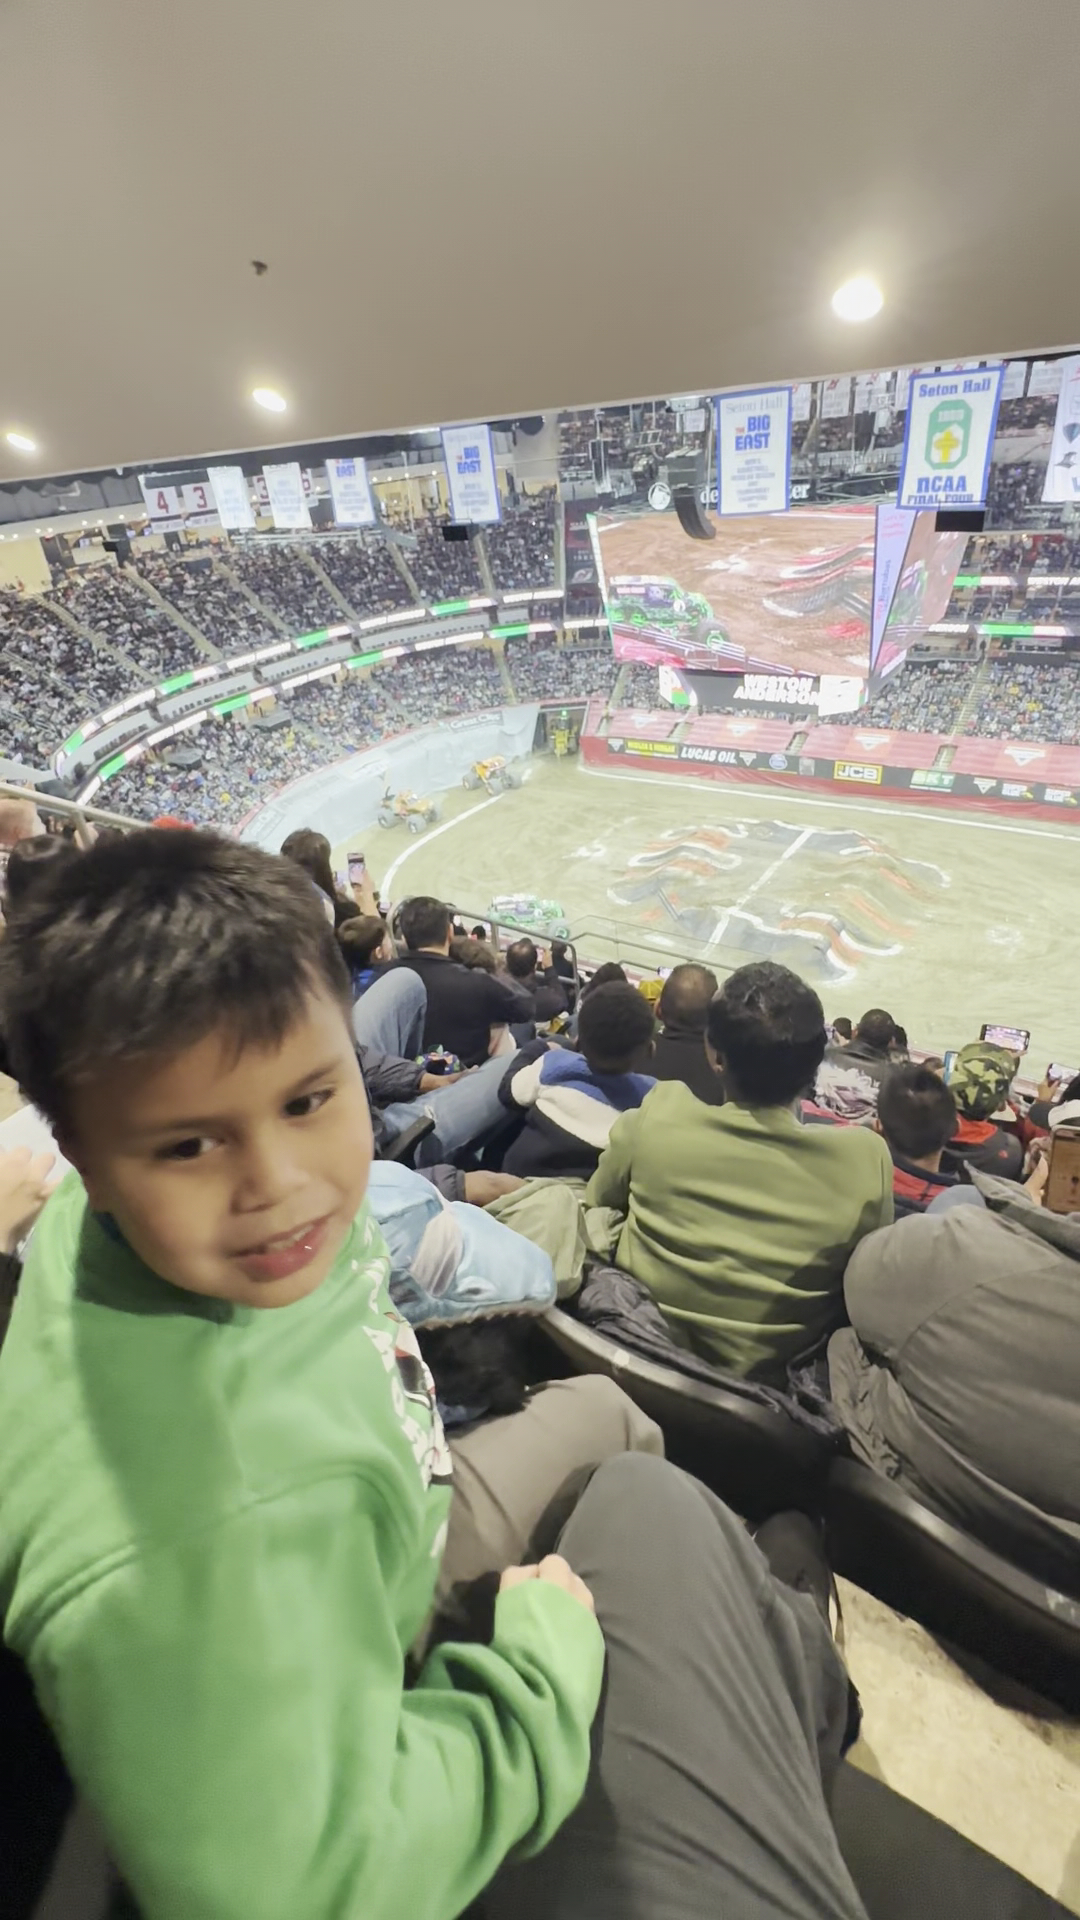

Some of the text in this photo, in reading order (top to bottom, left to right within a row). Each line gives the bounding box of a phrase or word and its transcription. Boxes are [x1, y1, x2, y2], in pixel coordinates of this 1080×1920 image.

[918, 377, 992, 398] Seton Hall
[747, 414, 770, 432] BIG
[734, 433, 770, 451] EAST
[157, 490, 169, 513] 4
[193, 486, 208, 509] 3
[744, 674, 813, 692] WESTON
[733, 685, 820, 706] ANDERSON
[680, 747, 717, 762] LUCAS
[717, 751, 738, 765] OIL
[837, 764, 878, 780] JCB
